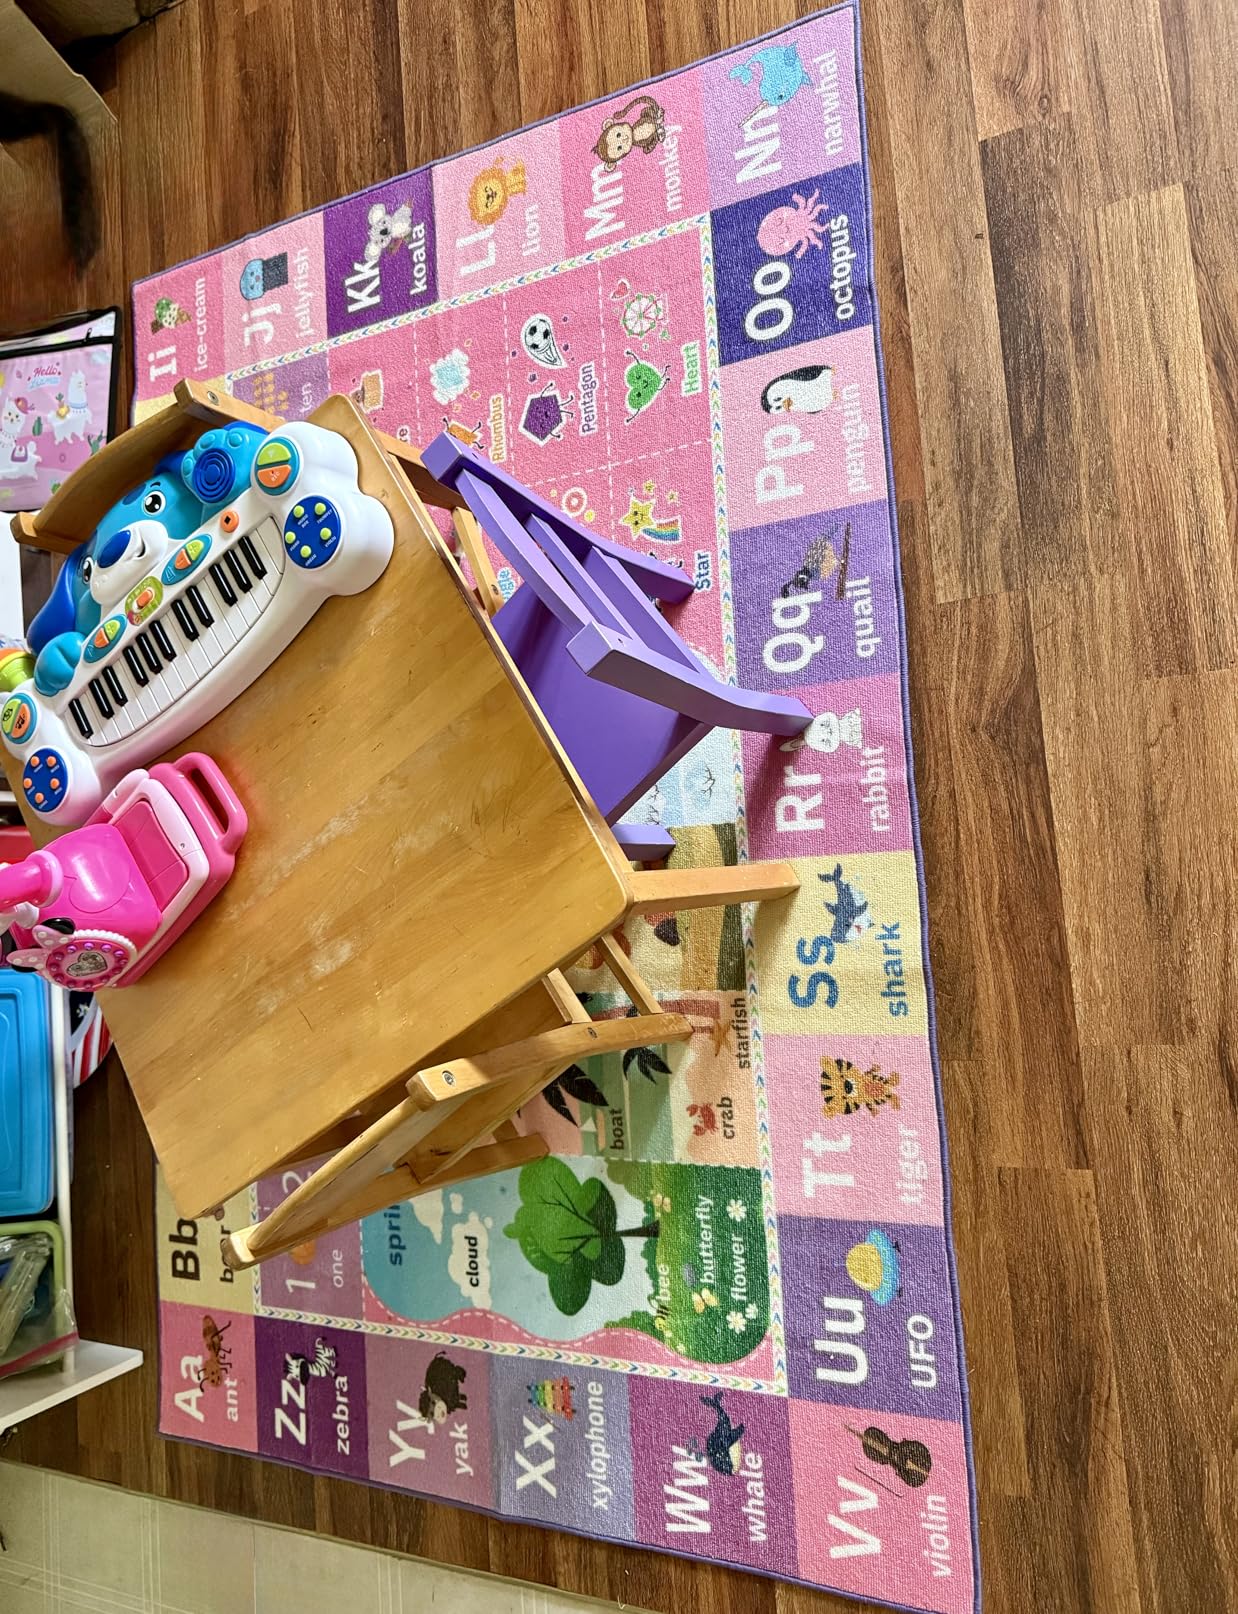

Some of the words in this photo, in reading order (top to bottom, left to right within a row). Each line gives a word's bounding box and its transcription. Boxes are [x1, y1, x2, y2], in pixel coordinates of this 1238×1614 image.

[813, 48, 845, 156] narwhal
[659, 123, 683, 212] monkey
[732, 104, 783, 185] Nn
[522, 203, 541, 257] lion
[583, 162, 626, 240] Mm
[295, 247, 312, 337] jellyfish
[345, 261, 383, 314] Kk
[409, 223, 427, 295] koala
[829, 213, 858, 322] octopus
[194, 277, 208, 371] ice-cream
[244, 301, 284, 347] Jj
[744, 260, 795, 342] Oo
[34, 365, 57, 377] Hello
[150, 344, 177, 381] Ii
[682, 344, 700, 394] Heart
[491, 395, 504, 462] Rhombus
[580, 364, 597, 435] Pentagon
[755, 424, 815, 504] Pp
[838, 383, 872, 494] penguin
[694, 551, 711, 591] Star
[762, 588, 827, 675] Qq
[855, 576, 883, 658] quail
[774, 766, 826, 834] Rr
[859, 745, 891, 834] rabbit
[787, 934, 840, 1010] Ss
[874, 920, 909, 1017] shark
[728, 996, 751, 1069] starfish
[609, 1107, 625, 1150] boat
[720, 1095, 735, 1140] crab
[801, 1131, 855, 1197] Tt
[895, 1125, 928, 1206] tiger
[169, 1217, 201, 1281] Bb
[220, 1225, 234, 1283] br
[332, 1249, 345, 1288] one
[384, 1203, 406, 1266] spri
[464, 1235, 480, 1288] cloud
[693, 1194, 717, 1285] butterfly
[728, 1233, 748, 1302] flower
[285, 1278, 316, 1293] 1
[654, 1263, 672, 1303] bee
[812, 1296, 868, 1387] Uu
[907, 1314, 939, 1389] UFO
[174, 1355, 205, 1424] Aa
[222, 1377, 240, 1423] ant
[274, 1377, 307, 1446] Zz
[332, 1375, 350, 1456] zebra
[388, 1399, 437, 1469] Yy
[448, 1422, 474, 1477] yak
[514, 1415, 558, 1499] Xx
[584, 1380, 614, 1511] xylophone
[663, 1445, 712, 1535] Ww
[739, 1451, 767, 1543] whale
[825, 1476, 883, 1560] Vv
[914, 1494, 953, 1578] violin
